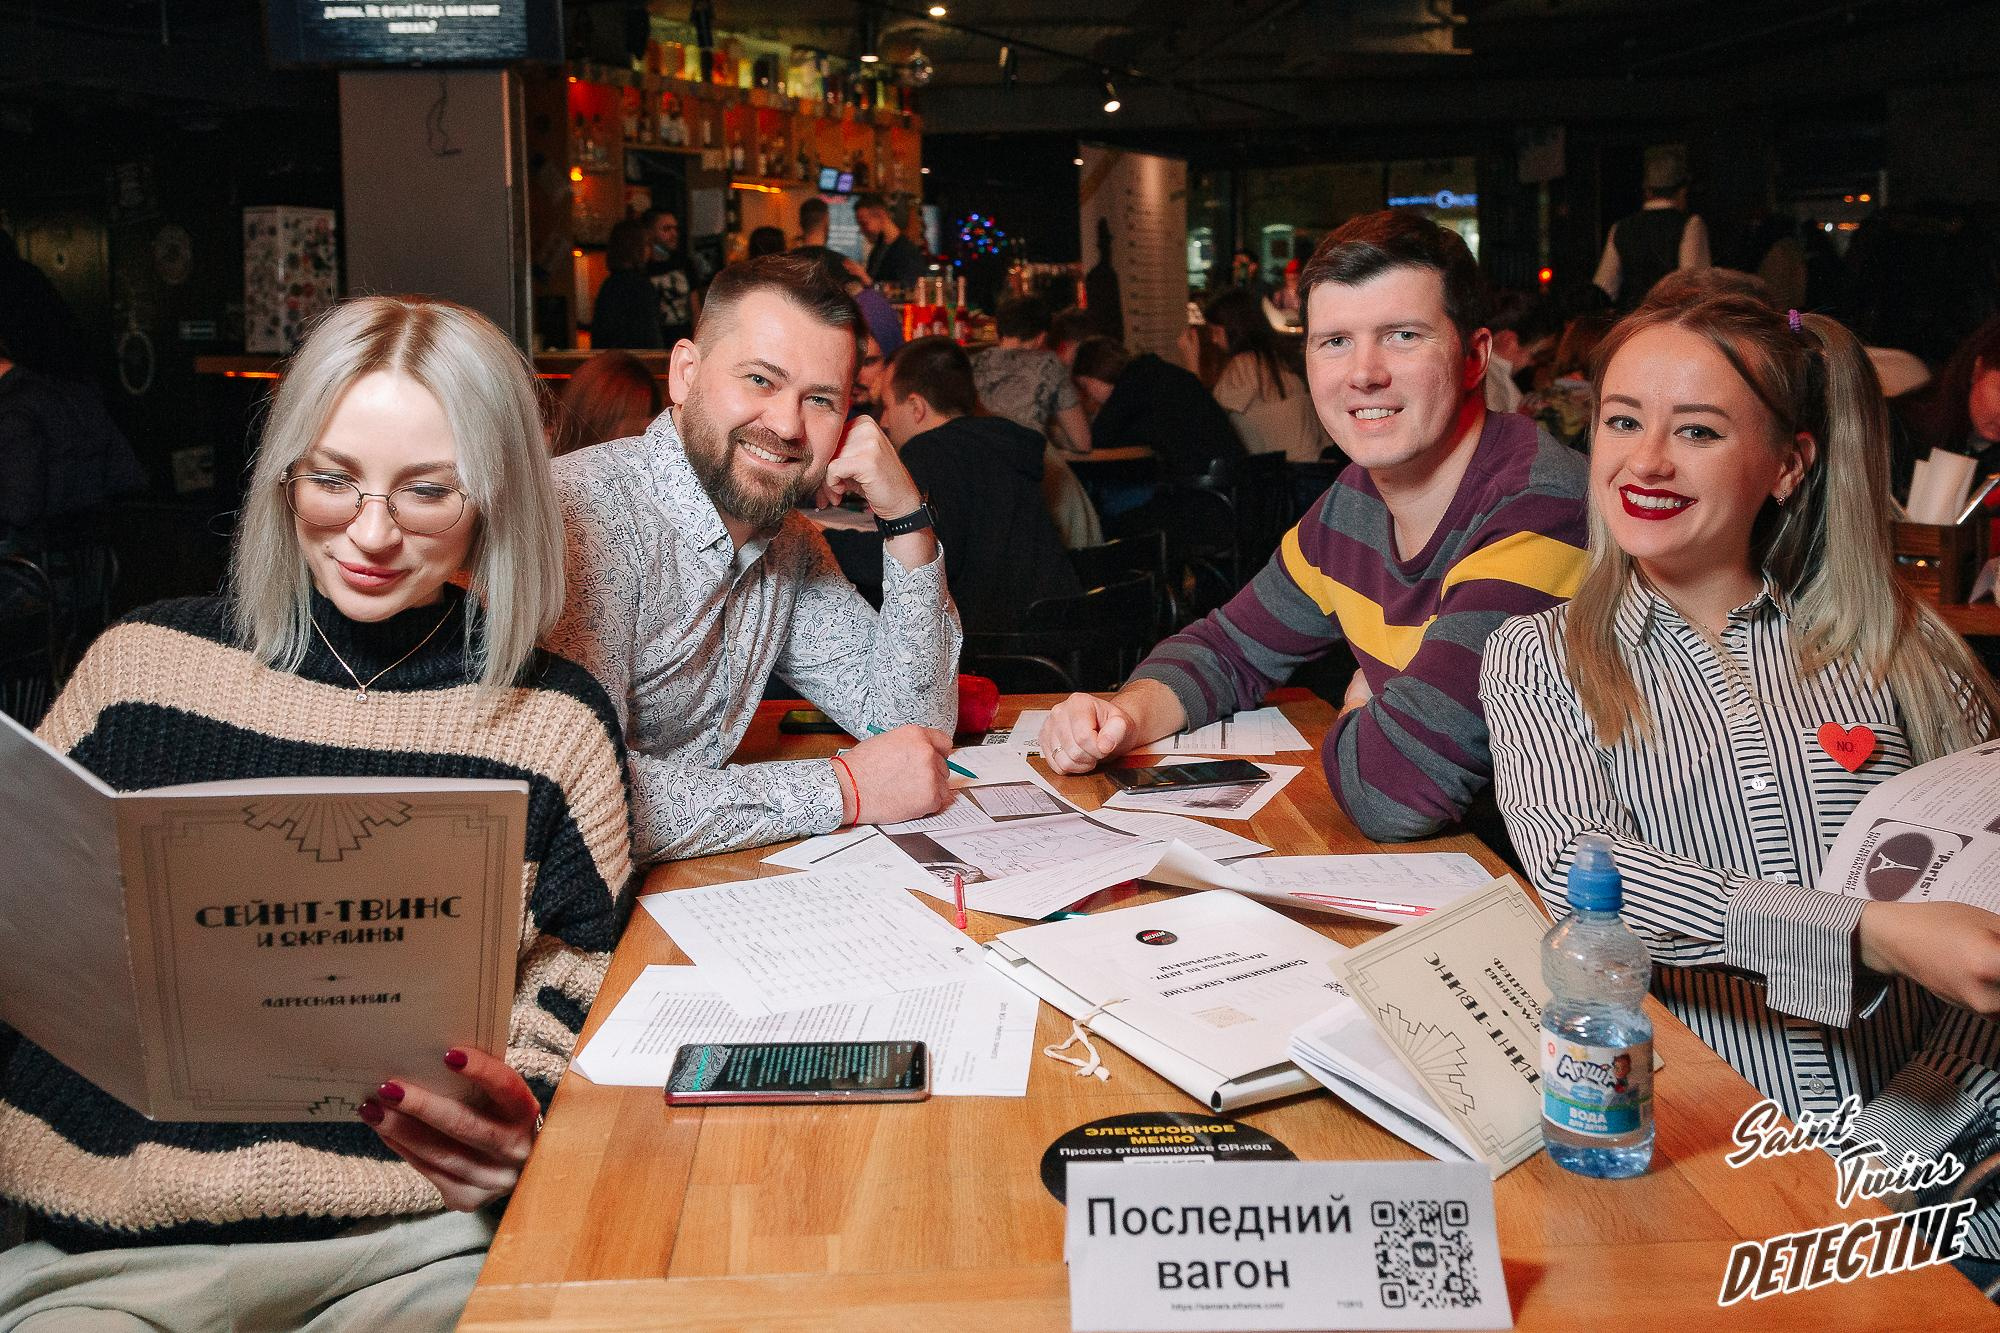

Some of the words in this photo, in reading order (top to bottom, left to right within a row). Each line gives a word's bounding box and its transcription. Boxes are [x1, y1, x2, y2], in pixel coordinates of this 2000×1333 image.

[1836, 741, 1854, 752] NO
[195, 896, 462, 928] СЕЙНТ-ТВИНС
[257, 932, 274, 948] И
[280, 926, 405, 947] ОКРАИНЫ
[261, 994, 346, 1009] АДРЕСНАЯ
[349, 992, 402, 1005] КНИГА
[1424, 951, 1541, 1096] ЕЙНТ-ТВИНС
[1084, 1124, 1236, 1137] ЭЛЕКТРОННОЕ
[1130, 1135, 1196, 1145] МЕНЮ
[1059, 1147, 1112, 1157] Просто
[1115, 1144, 1214, 1155] отсканируйте
[1087, 1193, 1352, 1241] Последний
[1157, 1260, 1290, 1290] вагон
